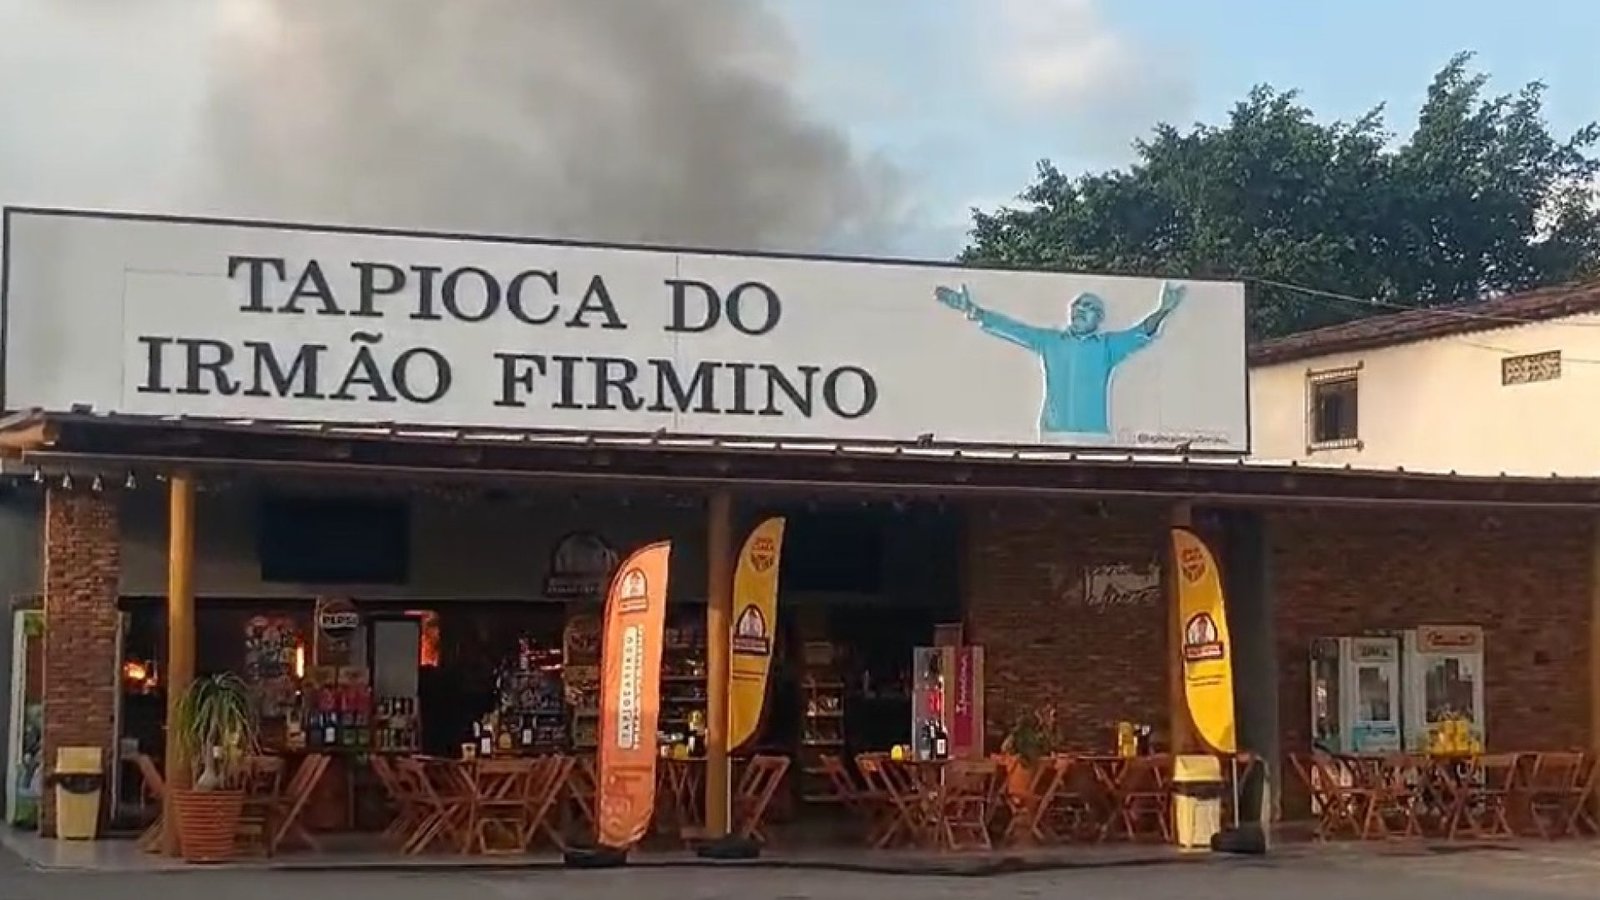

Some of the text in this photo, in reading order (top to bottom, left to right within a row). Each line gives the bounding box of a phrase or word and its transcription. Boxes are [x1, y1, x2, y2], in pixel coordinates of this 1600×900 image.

[228, 256, 782, 336] TAPIOCA DO
[137, 331, 879, 419] IRMÃO FIRMINO
